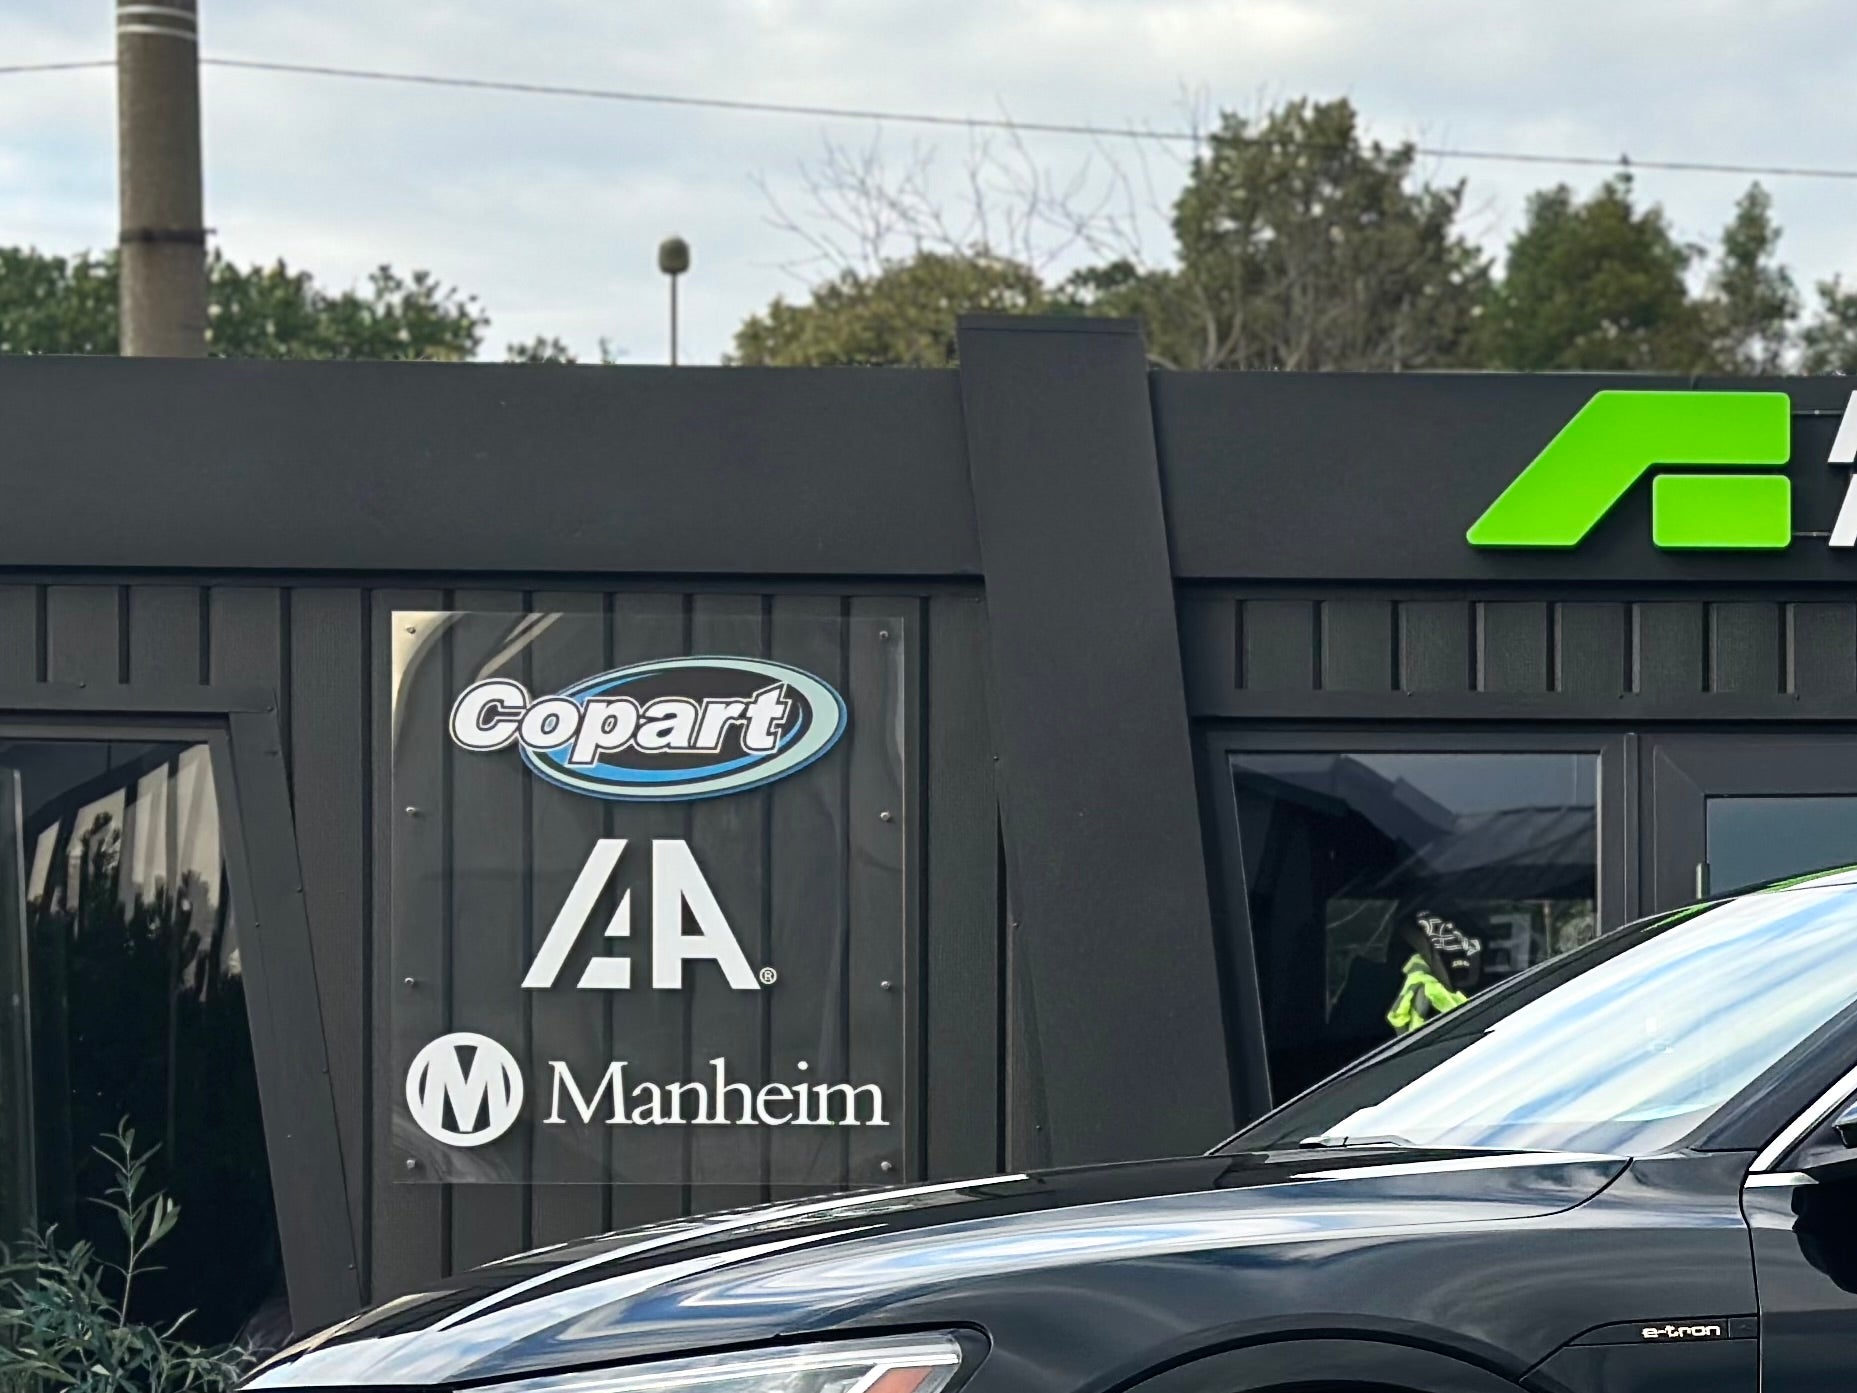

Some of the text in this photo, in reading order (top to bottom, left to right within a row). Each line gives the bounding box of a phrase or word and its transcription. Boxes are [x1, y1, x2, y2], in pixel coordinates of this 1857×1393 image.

[451, 679, 792, 765] Copart
[543, 1057, 890, 1126] Manheim
[1642, 1325, 1721, 1339] e-tron
